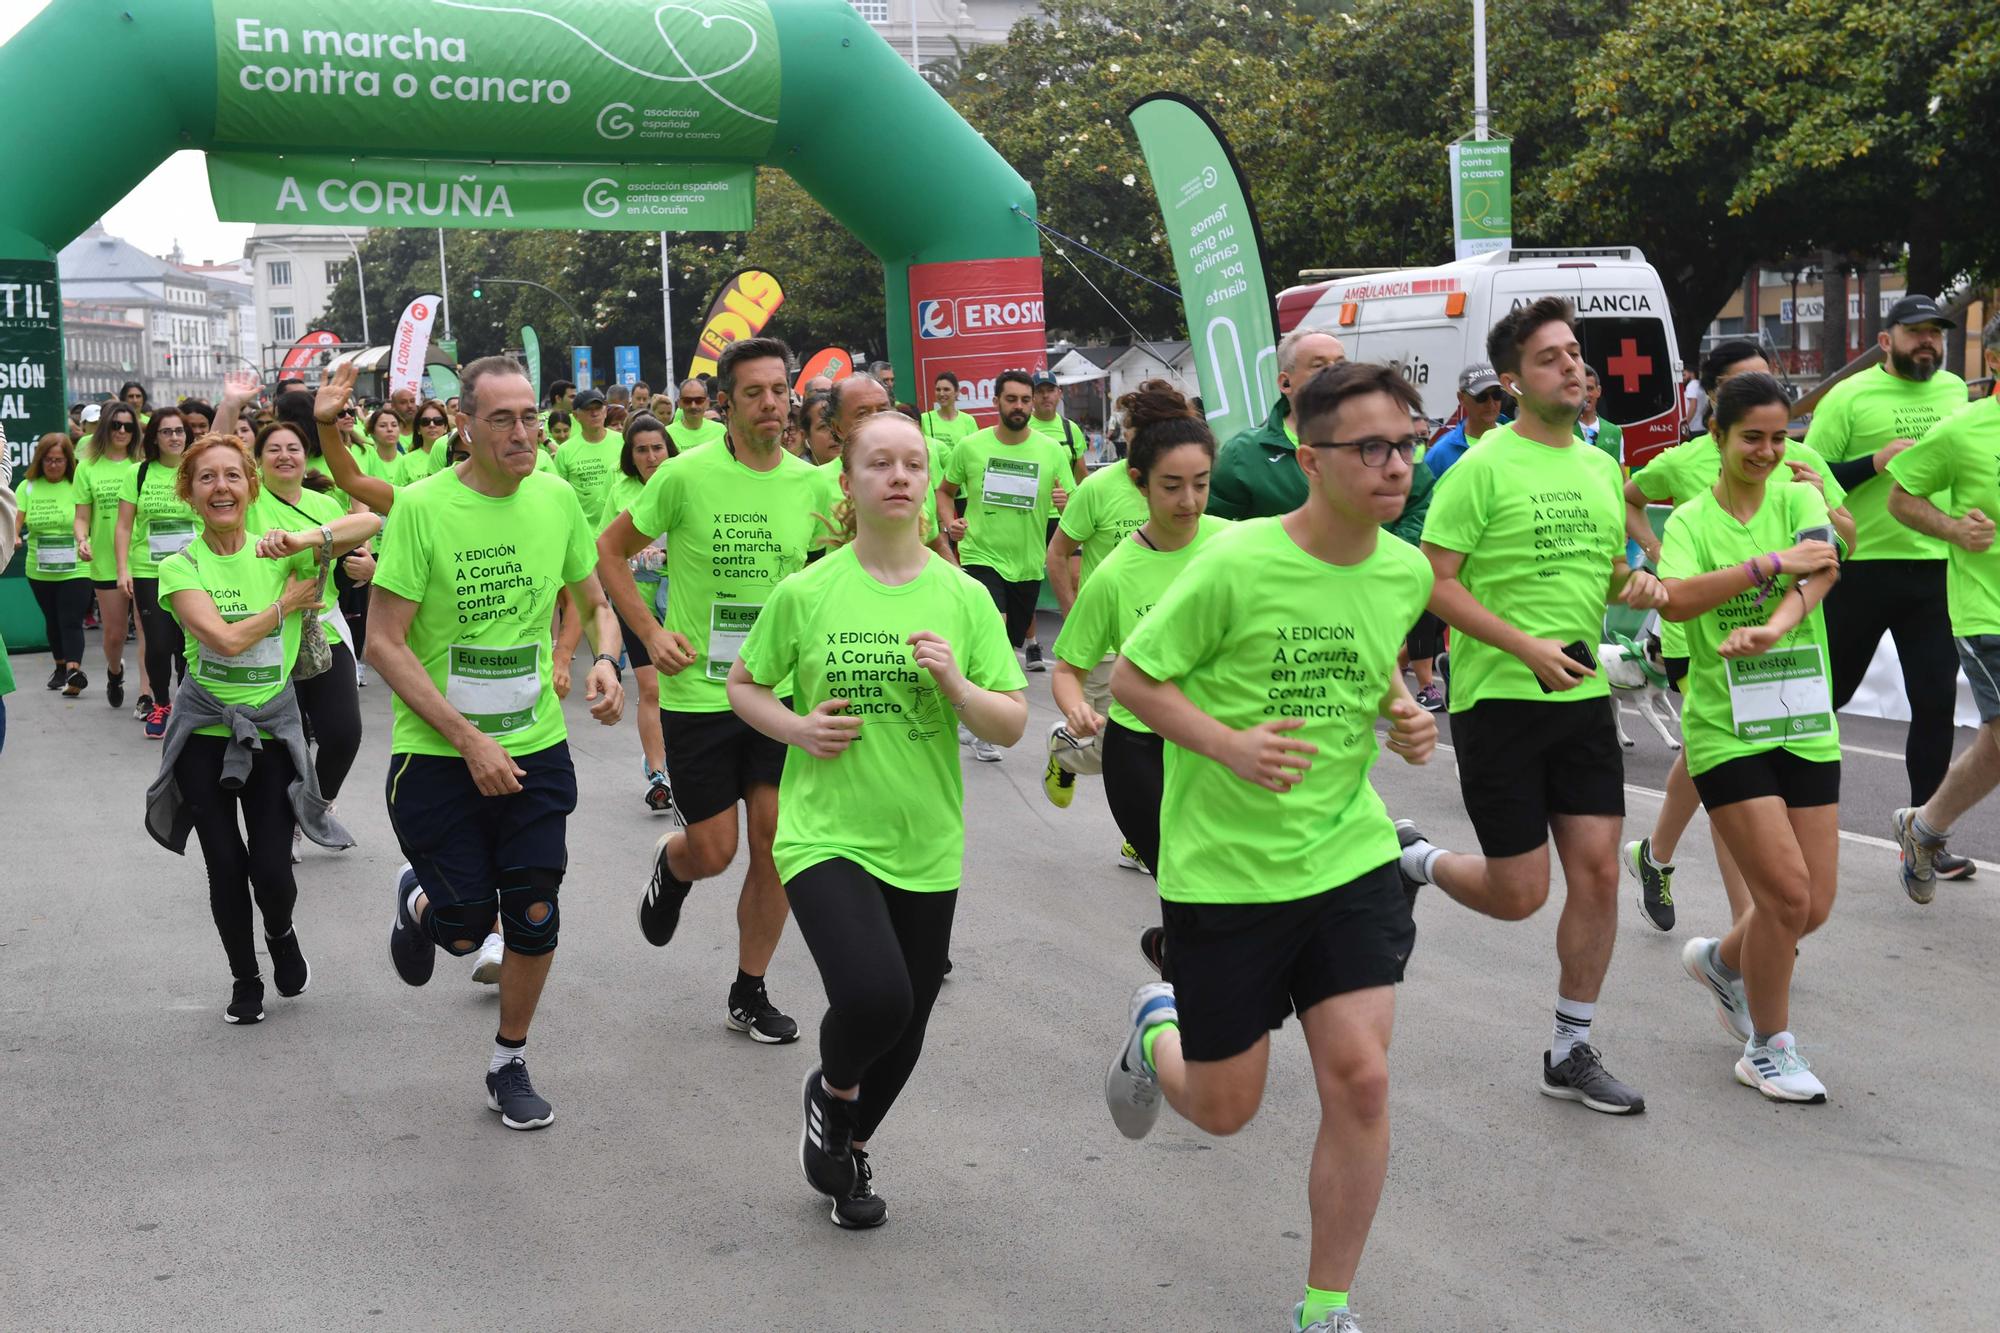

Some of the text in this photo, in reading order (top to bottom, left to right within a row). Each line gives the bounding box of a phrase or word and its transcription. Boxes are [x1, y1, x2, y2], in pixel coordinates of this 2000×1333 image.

[236, 18, 466, 63] En marcha
[239, 61, 571, 104] contra o cancro
[643, 107, 700, 118] asociación
[641, 119, 690, 129] española
[639, 130, 675, 139] contra
[684, 132, 721, 140] cancro
[1461, 145, 1509, 155] En marcha
[1461, 158, 1493, 167] contra
[1470, 169, 1504, 178] cancro
[627, 181, 729, 192] asociación española
[275, 174, 514, 217] A CORUÑA
[626, 194, 705, 203] contra o cancro
[627, 205, 689, 215] en A Coruña
[1344, 282, 1409, 300] AMBULANCIA
[1509, 294, 1651, 313] ALANCIA
[397, 320, 415, 366] CORUÑA
[1529, 490, 1582, 504] X EDICIÓN
[713, 511, 768, 524] X EDICIÓN
[1533, 505, 1589, 521] A Coruña
[1115, 520, 1122, 528] X
[1534, 520, 1597, 536] en marcha
[712, 527, 772, 540] A Coruña
[1114, 531, 1122, 540] A
[712, 541, 782, 553] en marcha
[1534, 537, 1575, 550] contra
[454, 543, 516, 563] X EDICIÓN
[712, 554, 755, 565] contra
[456, 561, 523, 581] A Coruña
[712, 568, 769, 578] o cancro
[456, 574, 533, 596] en marcha
[457, 594, 506, 611] contra
[721, 609, 760, 621] Eu est
[1716, 604, 1763, 617] contra
[458, 614, 468, 624] o
[1718, 621, 1728, 631] o
[827, 630, 899, 645] X EDICIÓN
[1277, 622, 1355, 641] X EDICIÓN
[459, 651, 518, 666] Eu estou
[825, 650, 906, 666] A Coruña
[1272, 647, 1359, 665] A Coruña
[1736, 655, 1797, 672] Eu estou
[826, 667, 919, 683] en marcha
[1271, 665, 1366, 682] en marcha
[829, 684, 883, 698] contra
[1268, 684, 1327, 700] contra
[844, 702, 902, 715] cancro
[1263, 703, 1346, 718] o cancro
